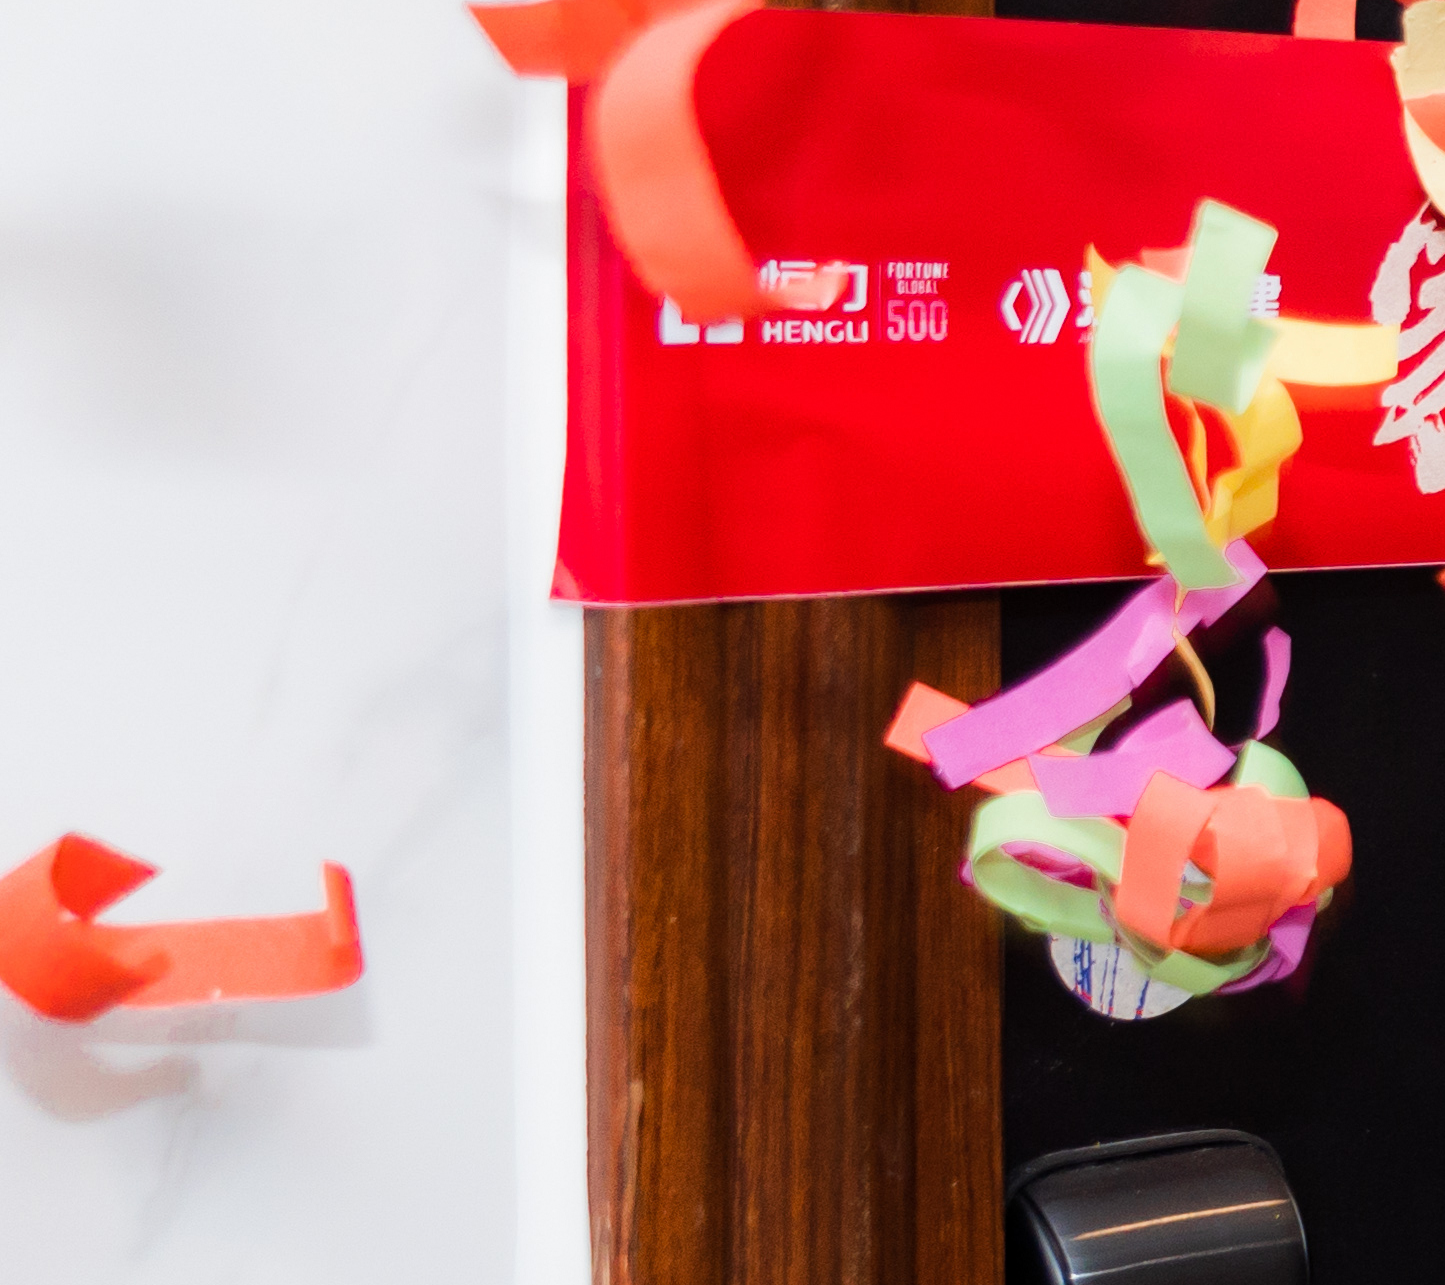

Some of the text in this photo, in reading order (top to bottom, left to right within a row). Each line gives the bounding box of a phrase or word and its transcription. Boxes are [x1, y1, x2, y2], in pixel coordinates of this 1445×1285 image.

[886, 261, 950, 280] FORTUNE
[895, 279, 939, 296] GLOBAL
[886, 299, 949, 342] 500
[761, 320, 869, 344] HENGLI
